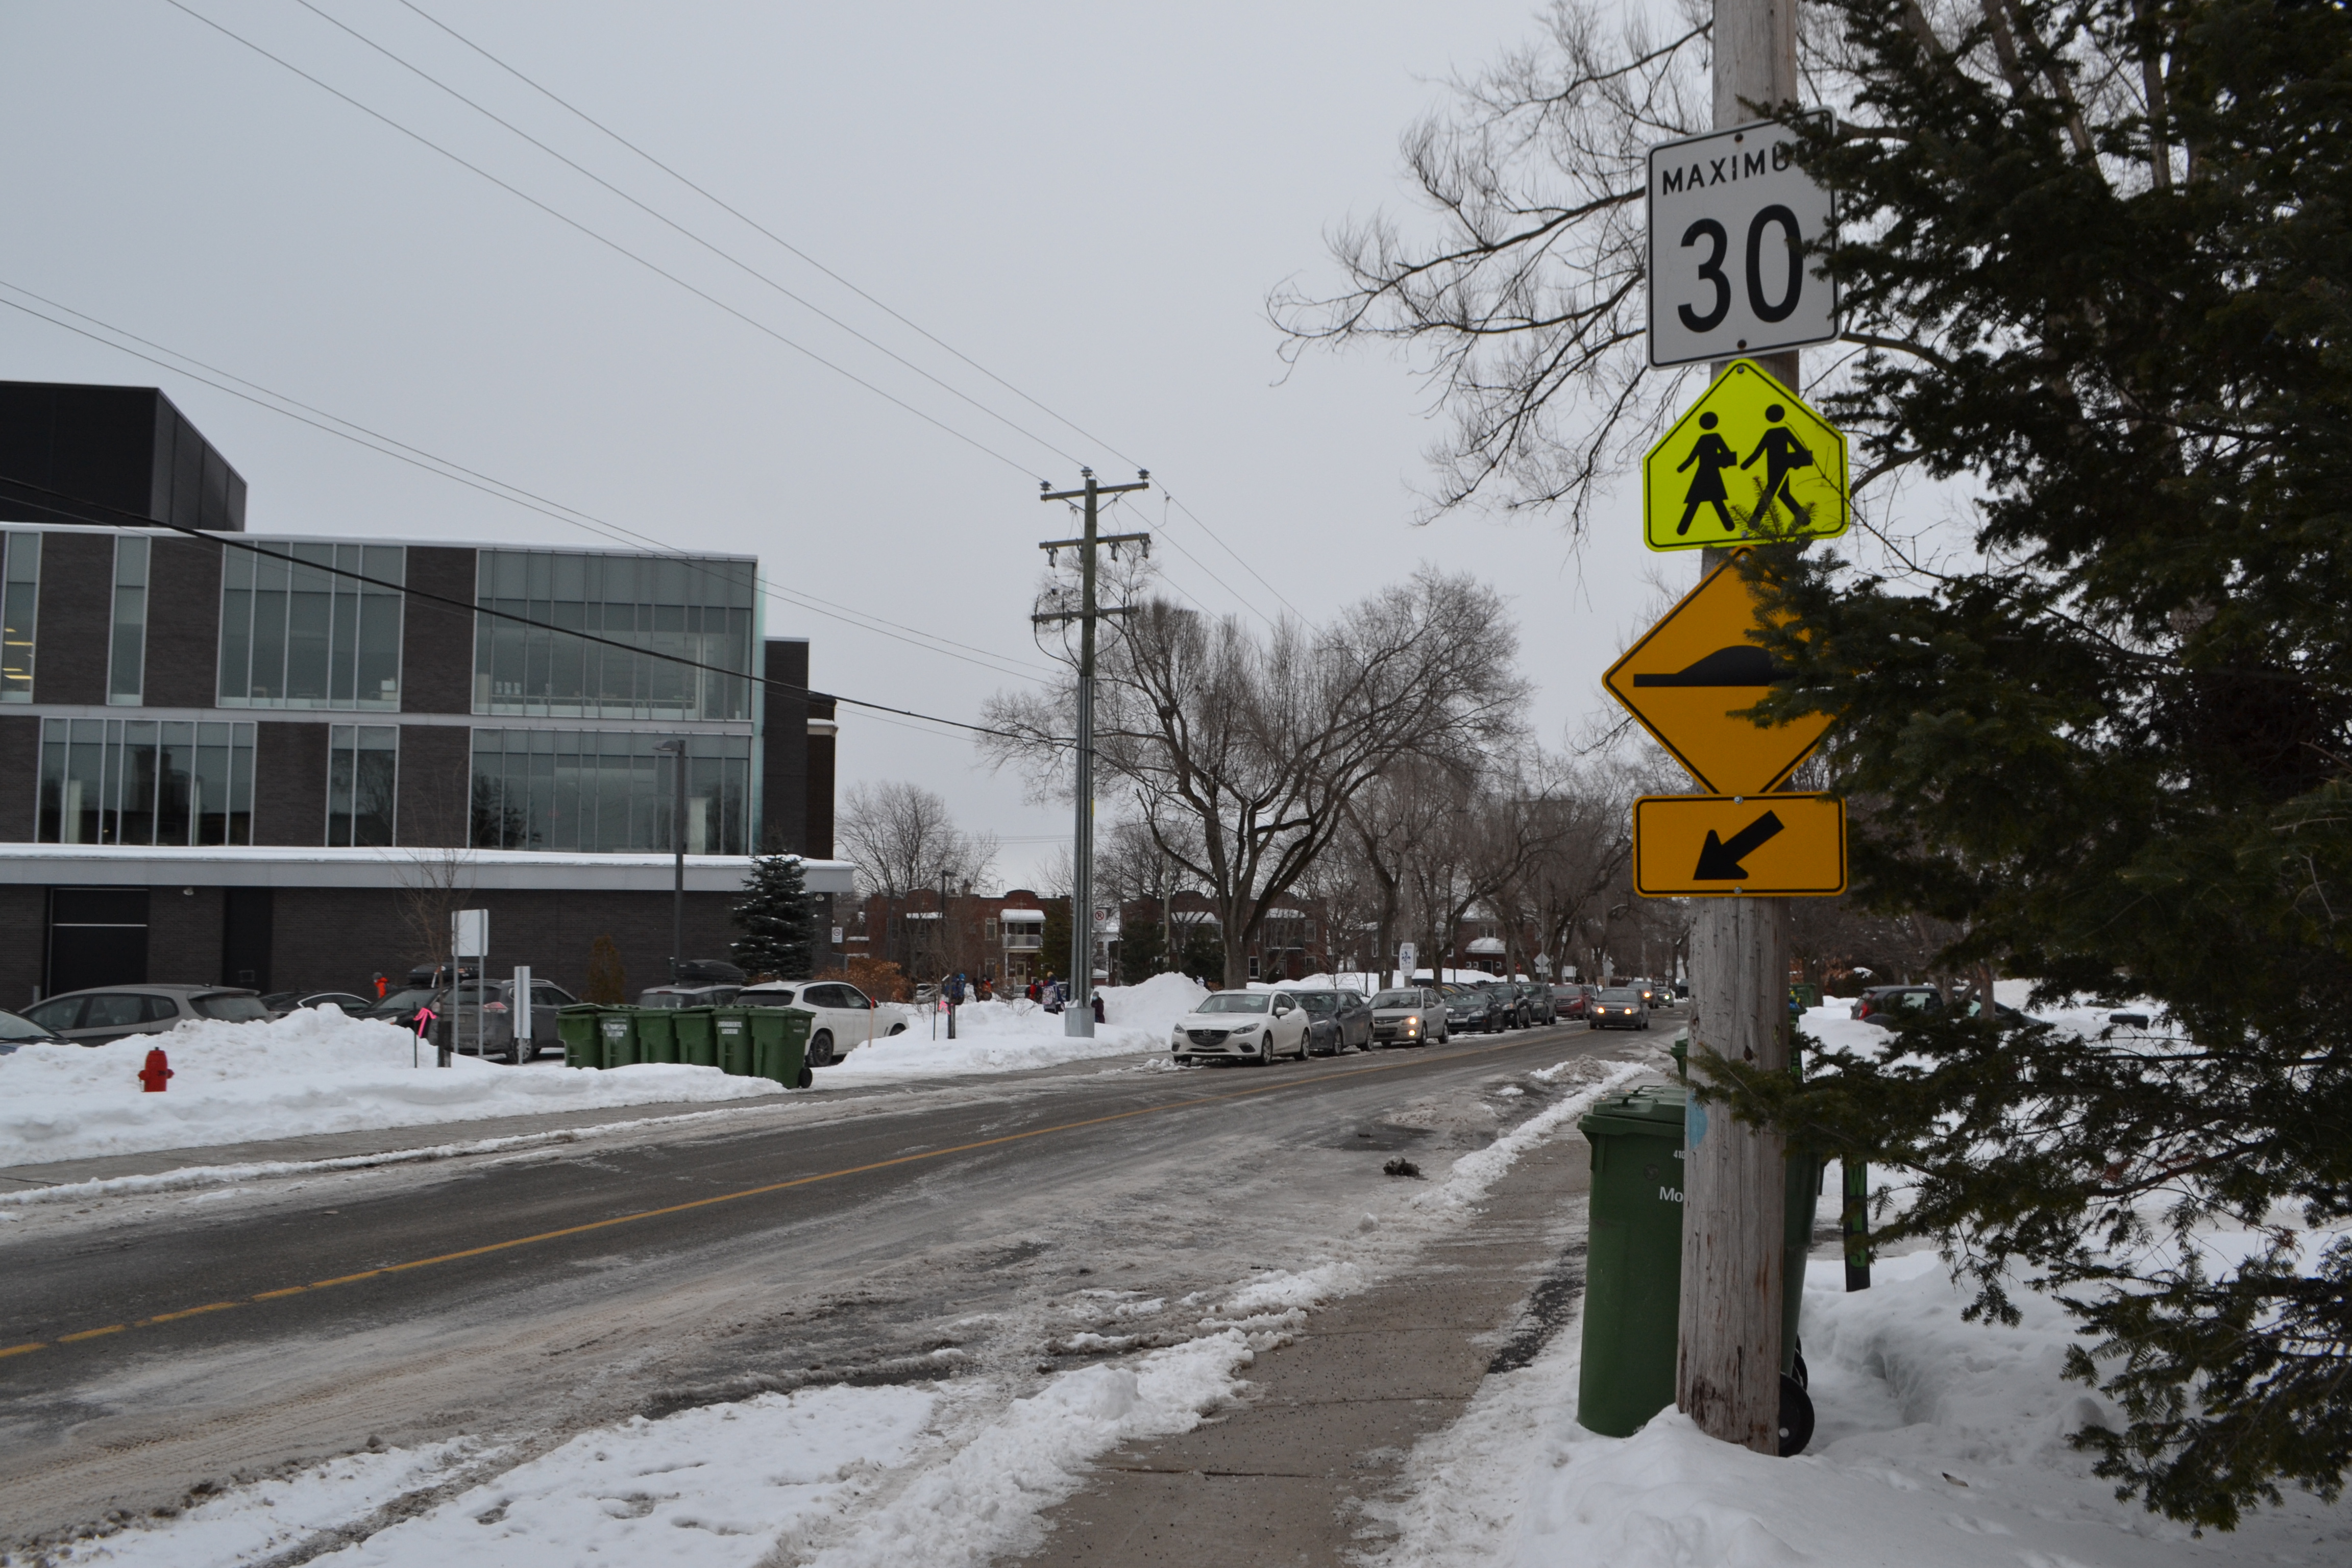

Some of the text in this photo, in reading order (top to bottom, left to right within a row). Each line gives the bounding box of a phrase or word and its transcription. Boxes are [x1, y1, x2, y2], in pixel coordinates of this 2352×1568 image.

[1662, 147, 1791, 195] MAXIMU
[1678, 204, 1803, 333] 30
[1659, 1186, 1684, 1203] Mo
